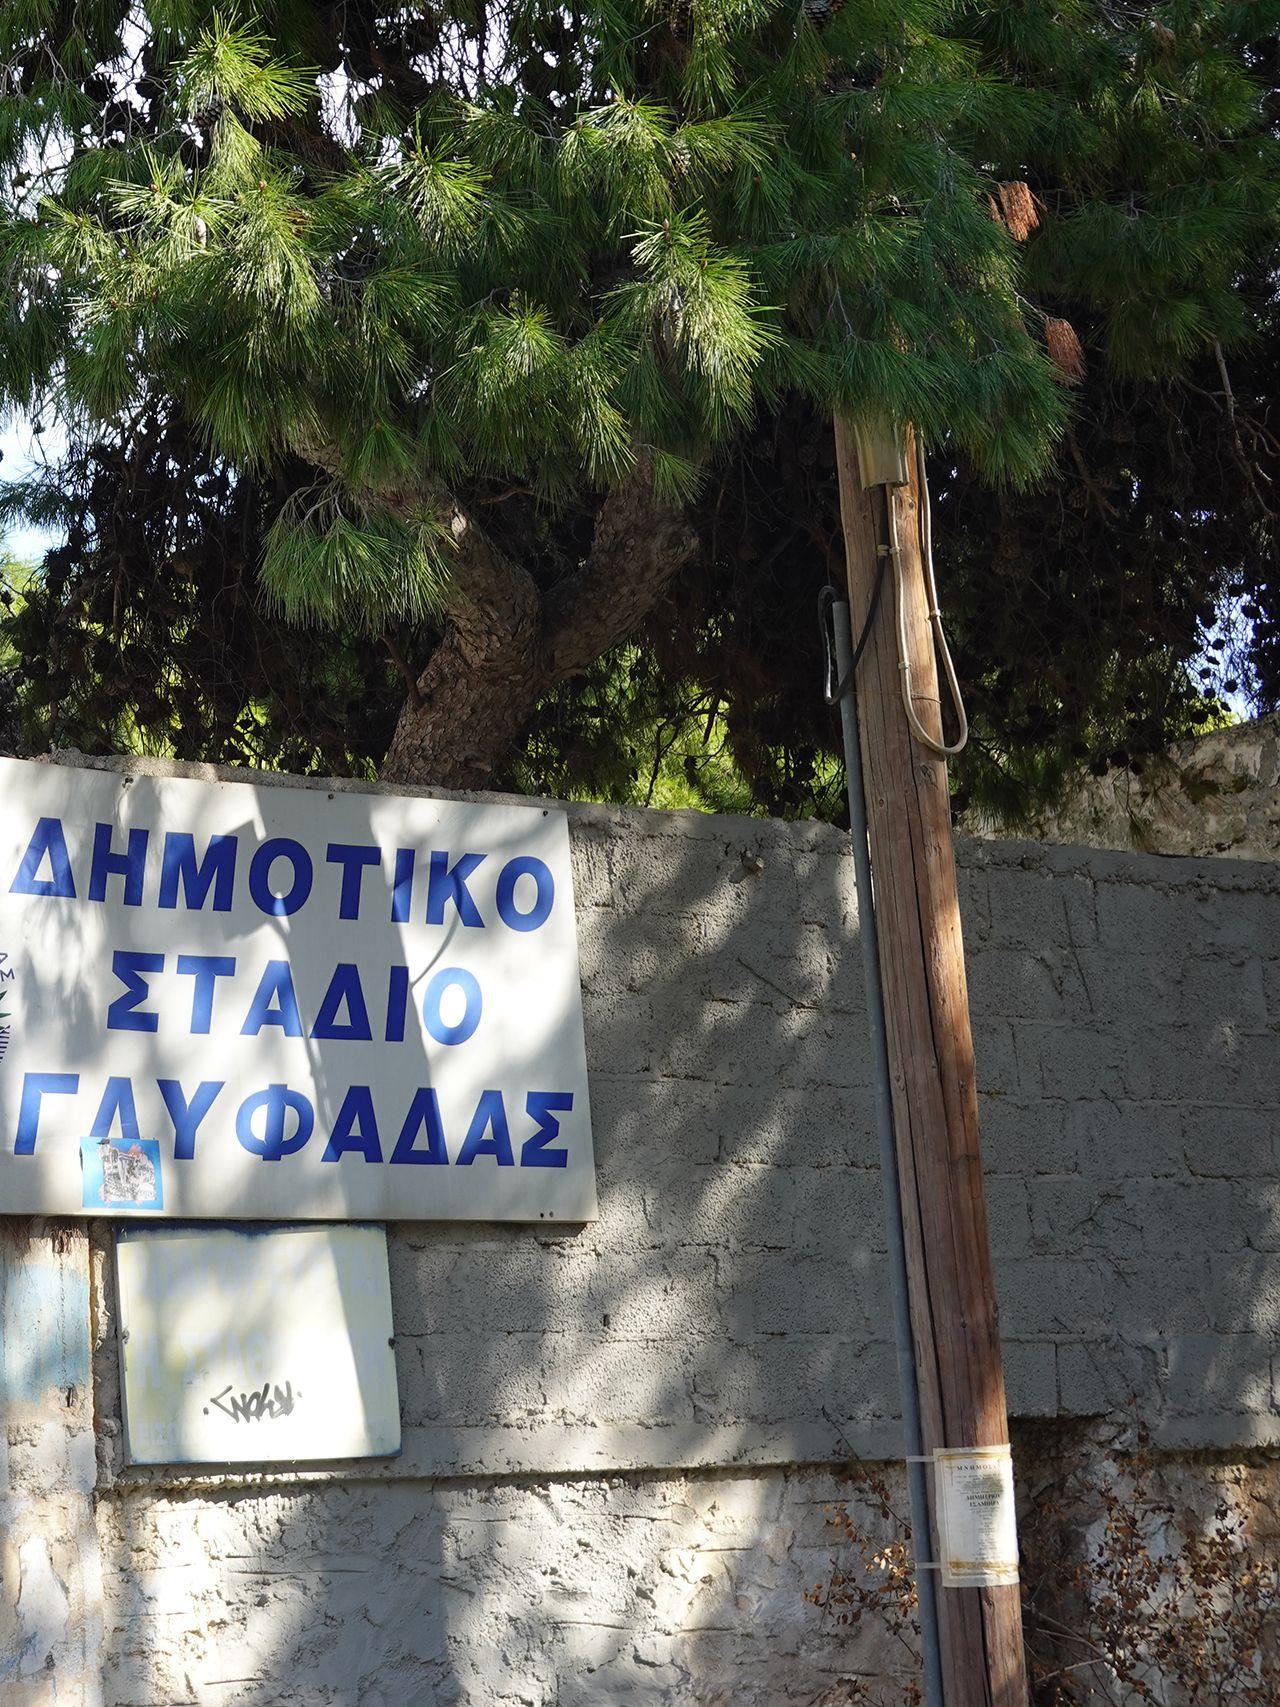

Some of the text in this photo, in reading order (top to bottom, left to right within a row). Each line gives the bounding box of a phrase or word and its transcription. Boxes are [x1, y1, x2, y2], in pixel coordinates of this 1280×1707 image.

[9, 817, 554, 932] ΔΗΜΟΤΙΚΟ
[107, 950, 483, 1046] ΣΤΑΔΙΟ
[14, 1073, 575, 1169] ΓΛΥΦΑΔΑΣ
